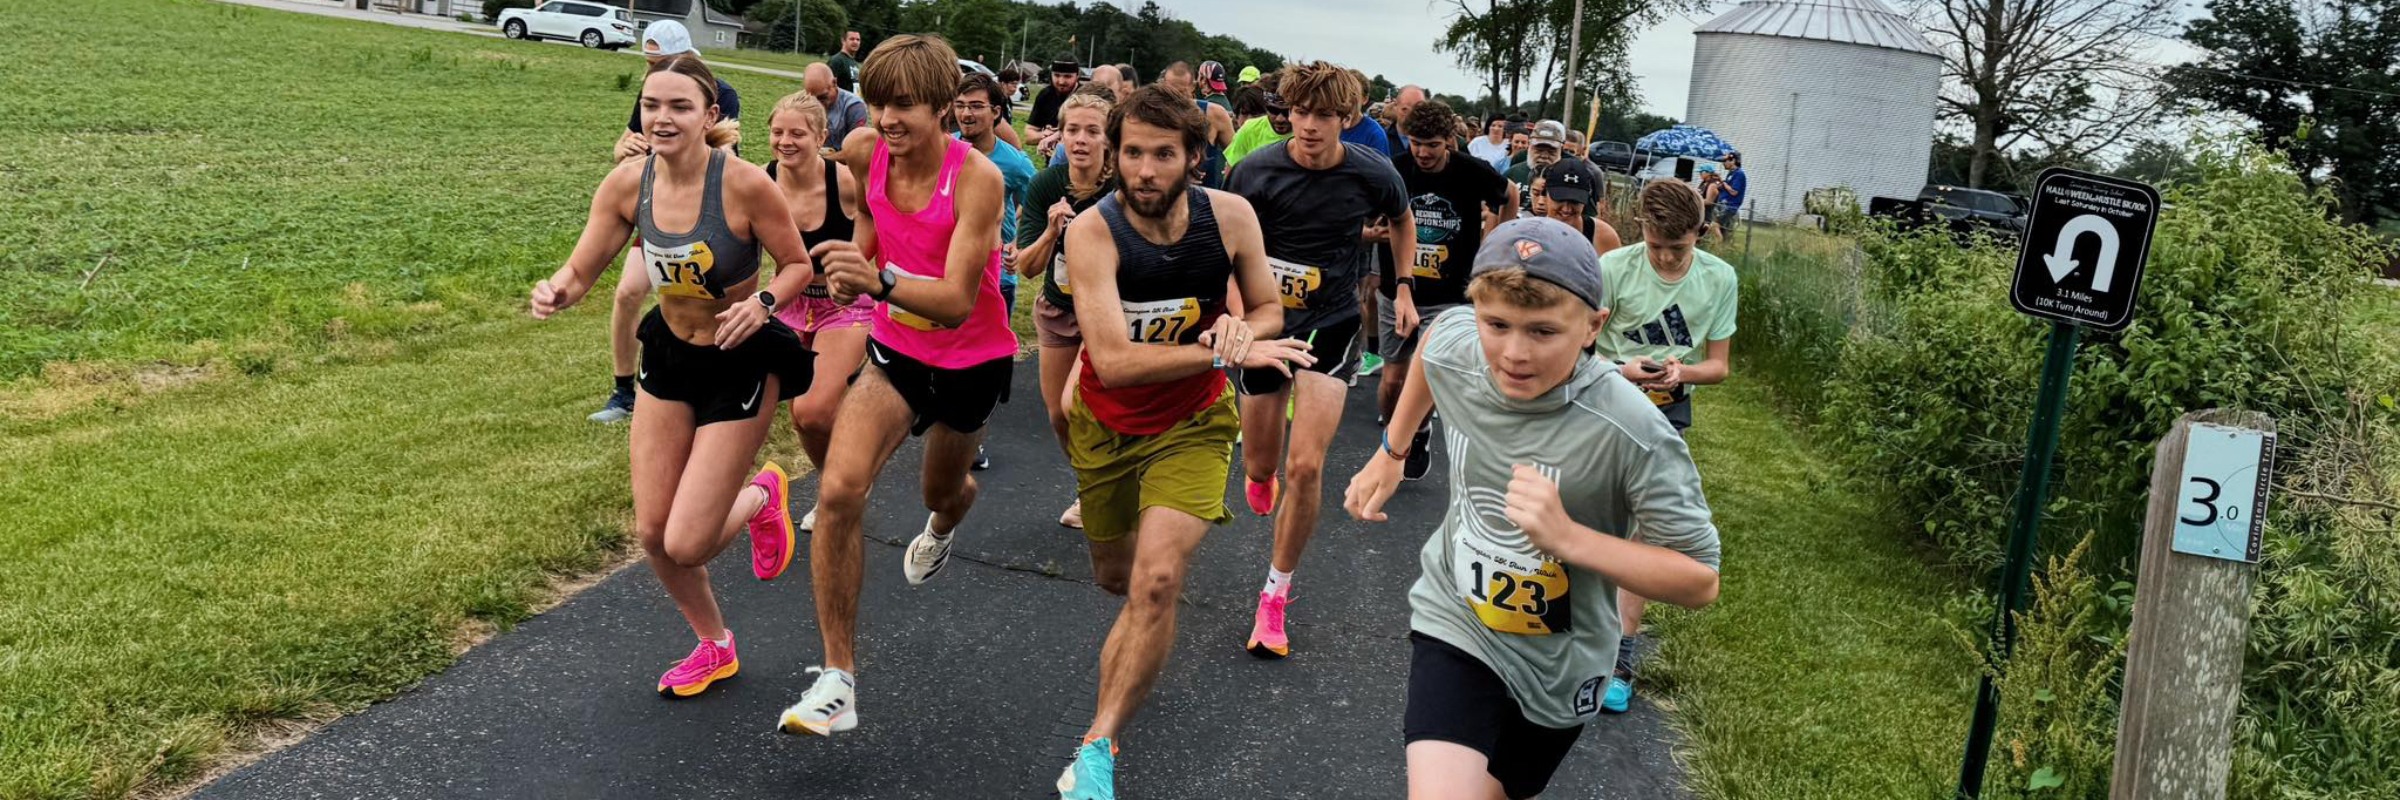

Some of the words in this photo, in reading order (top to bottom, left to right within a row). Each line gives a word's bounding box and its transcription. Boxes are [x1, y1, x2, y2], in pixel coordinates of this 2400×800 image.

[2054, 196, 2070, 206] Last
[2071, 200, 2100, 213] Saturday
[2108, 207, 2134, 218] October
[655, 260, 705, 286] 173
[1273, 272, 1308, 299] 53
[2035, 296, 2054, 308] (10K
[2055, 301, 2074, 313] Turn
[2075, 305, 2109, 321] Around)
[2056, 287, 2069, 299] 3.1
[2070, 290, 2093, 304] Miles
[1130, 316, 1186, 343] 127
[2262, 436, 2274, 463] Trail
[2257, 466, 2268, 497] Circle
[2248, 501, 2264, 555] Covington
[1471, 561, 1548, 616] 123
